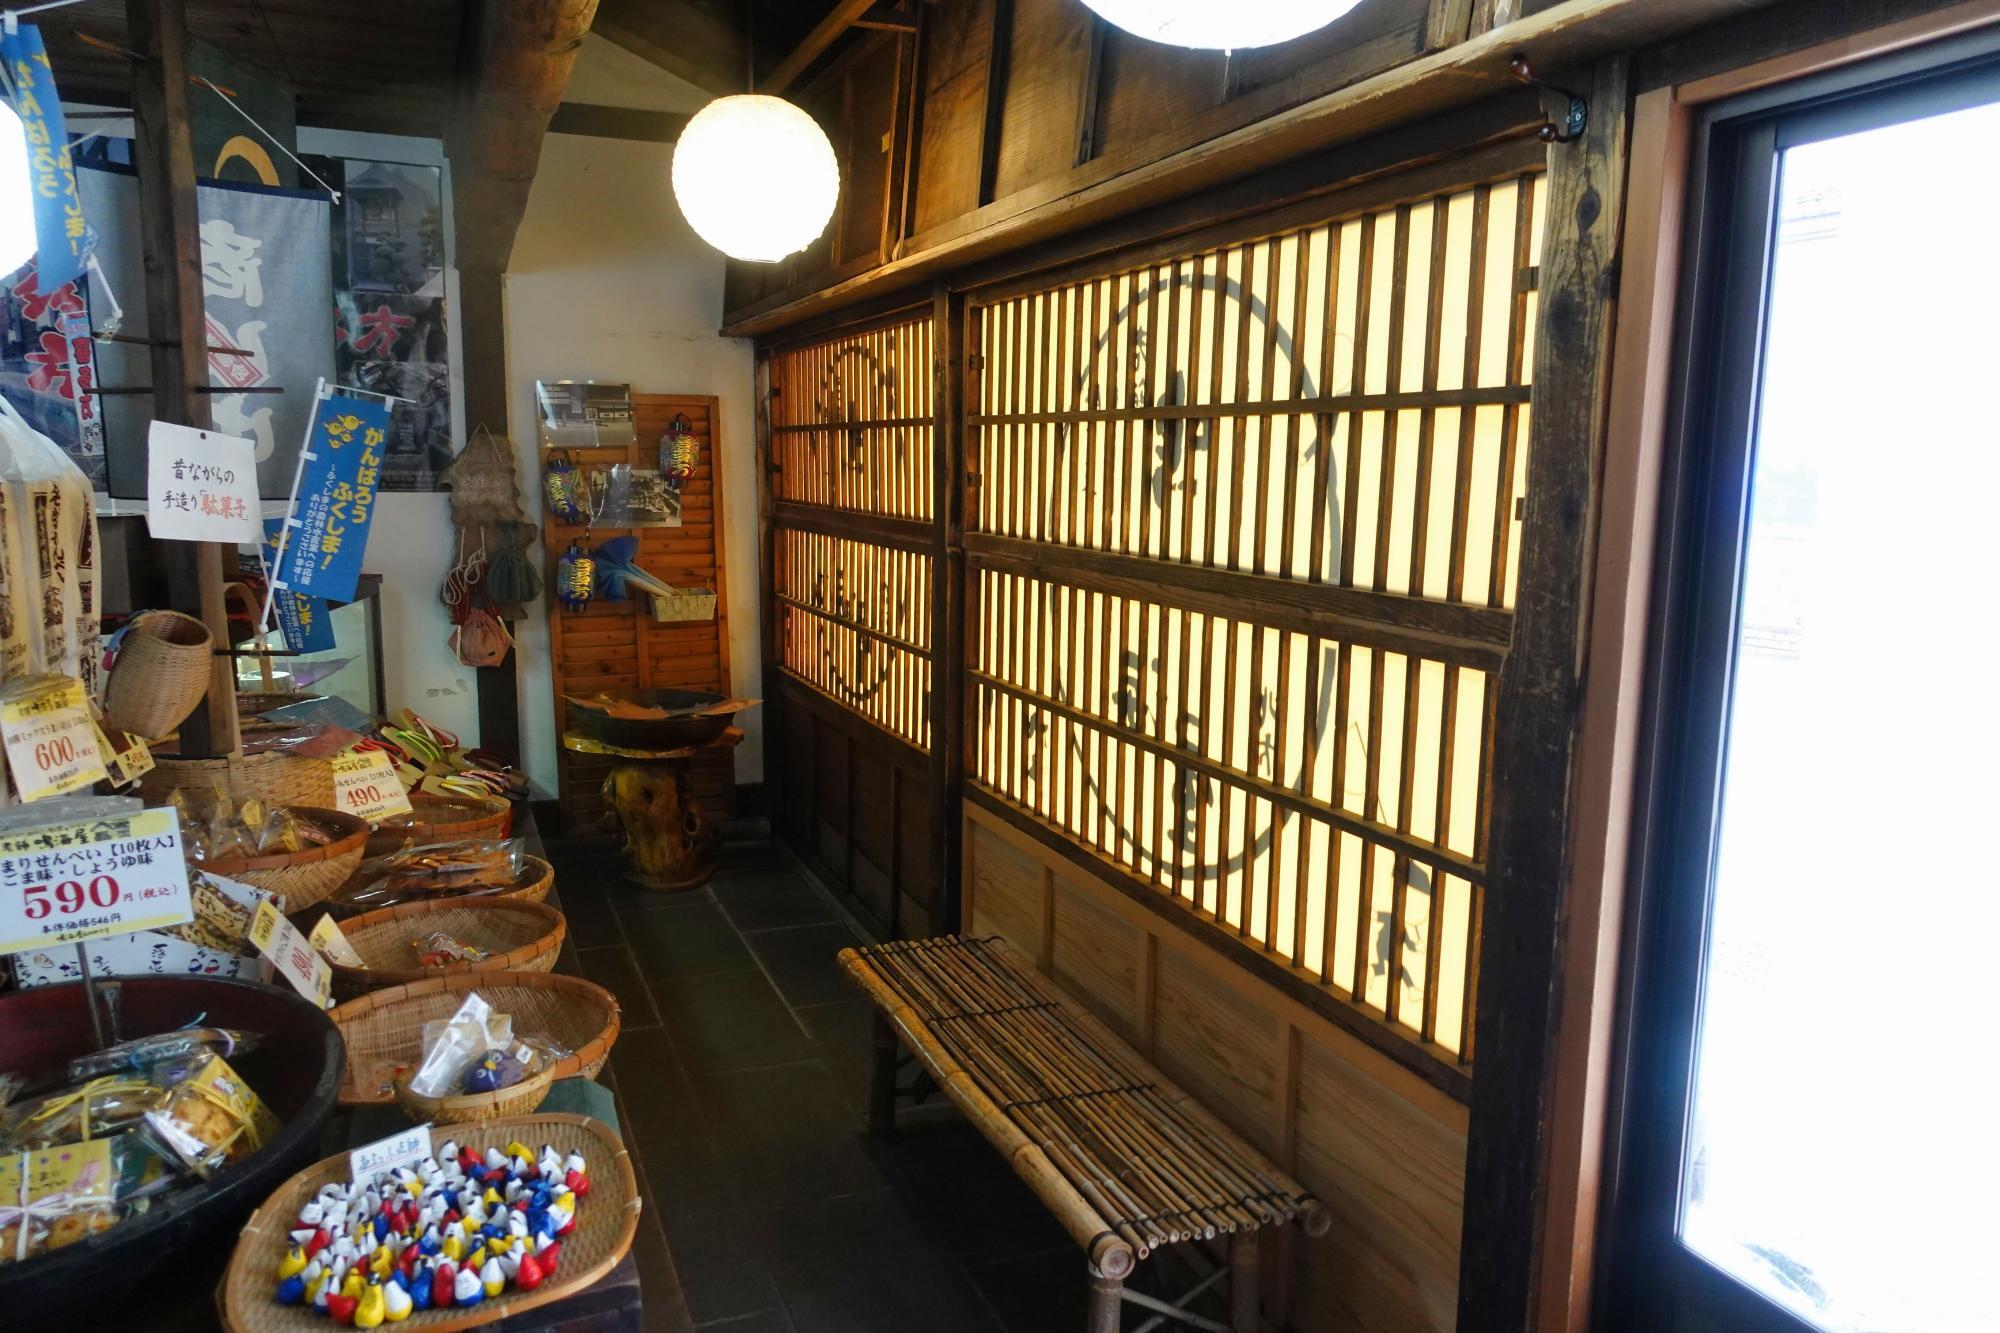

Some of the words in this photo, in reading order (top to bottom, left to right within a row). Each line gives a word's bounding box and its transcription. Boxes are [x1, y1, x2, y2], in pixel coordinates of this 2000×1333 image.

[171, 457, 235, 485] 昔ながらの
[351, 427, 385, 524] がんばろう
[319, 481, 353, 570] ふくしま！
[1, 835, 176, 874] まりせんべい【10枚入】
[3, 852, 154, 887] ごま味・しょうゆ味
[42, 912, 122, 934] 本体価格546円
